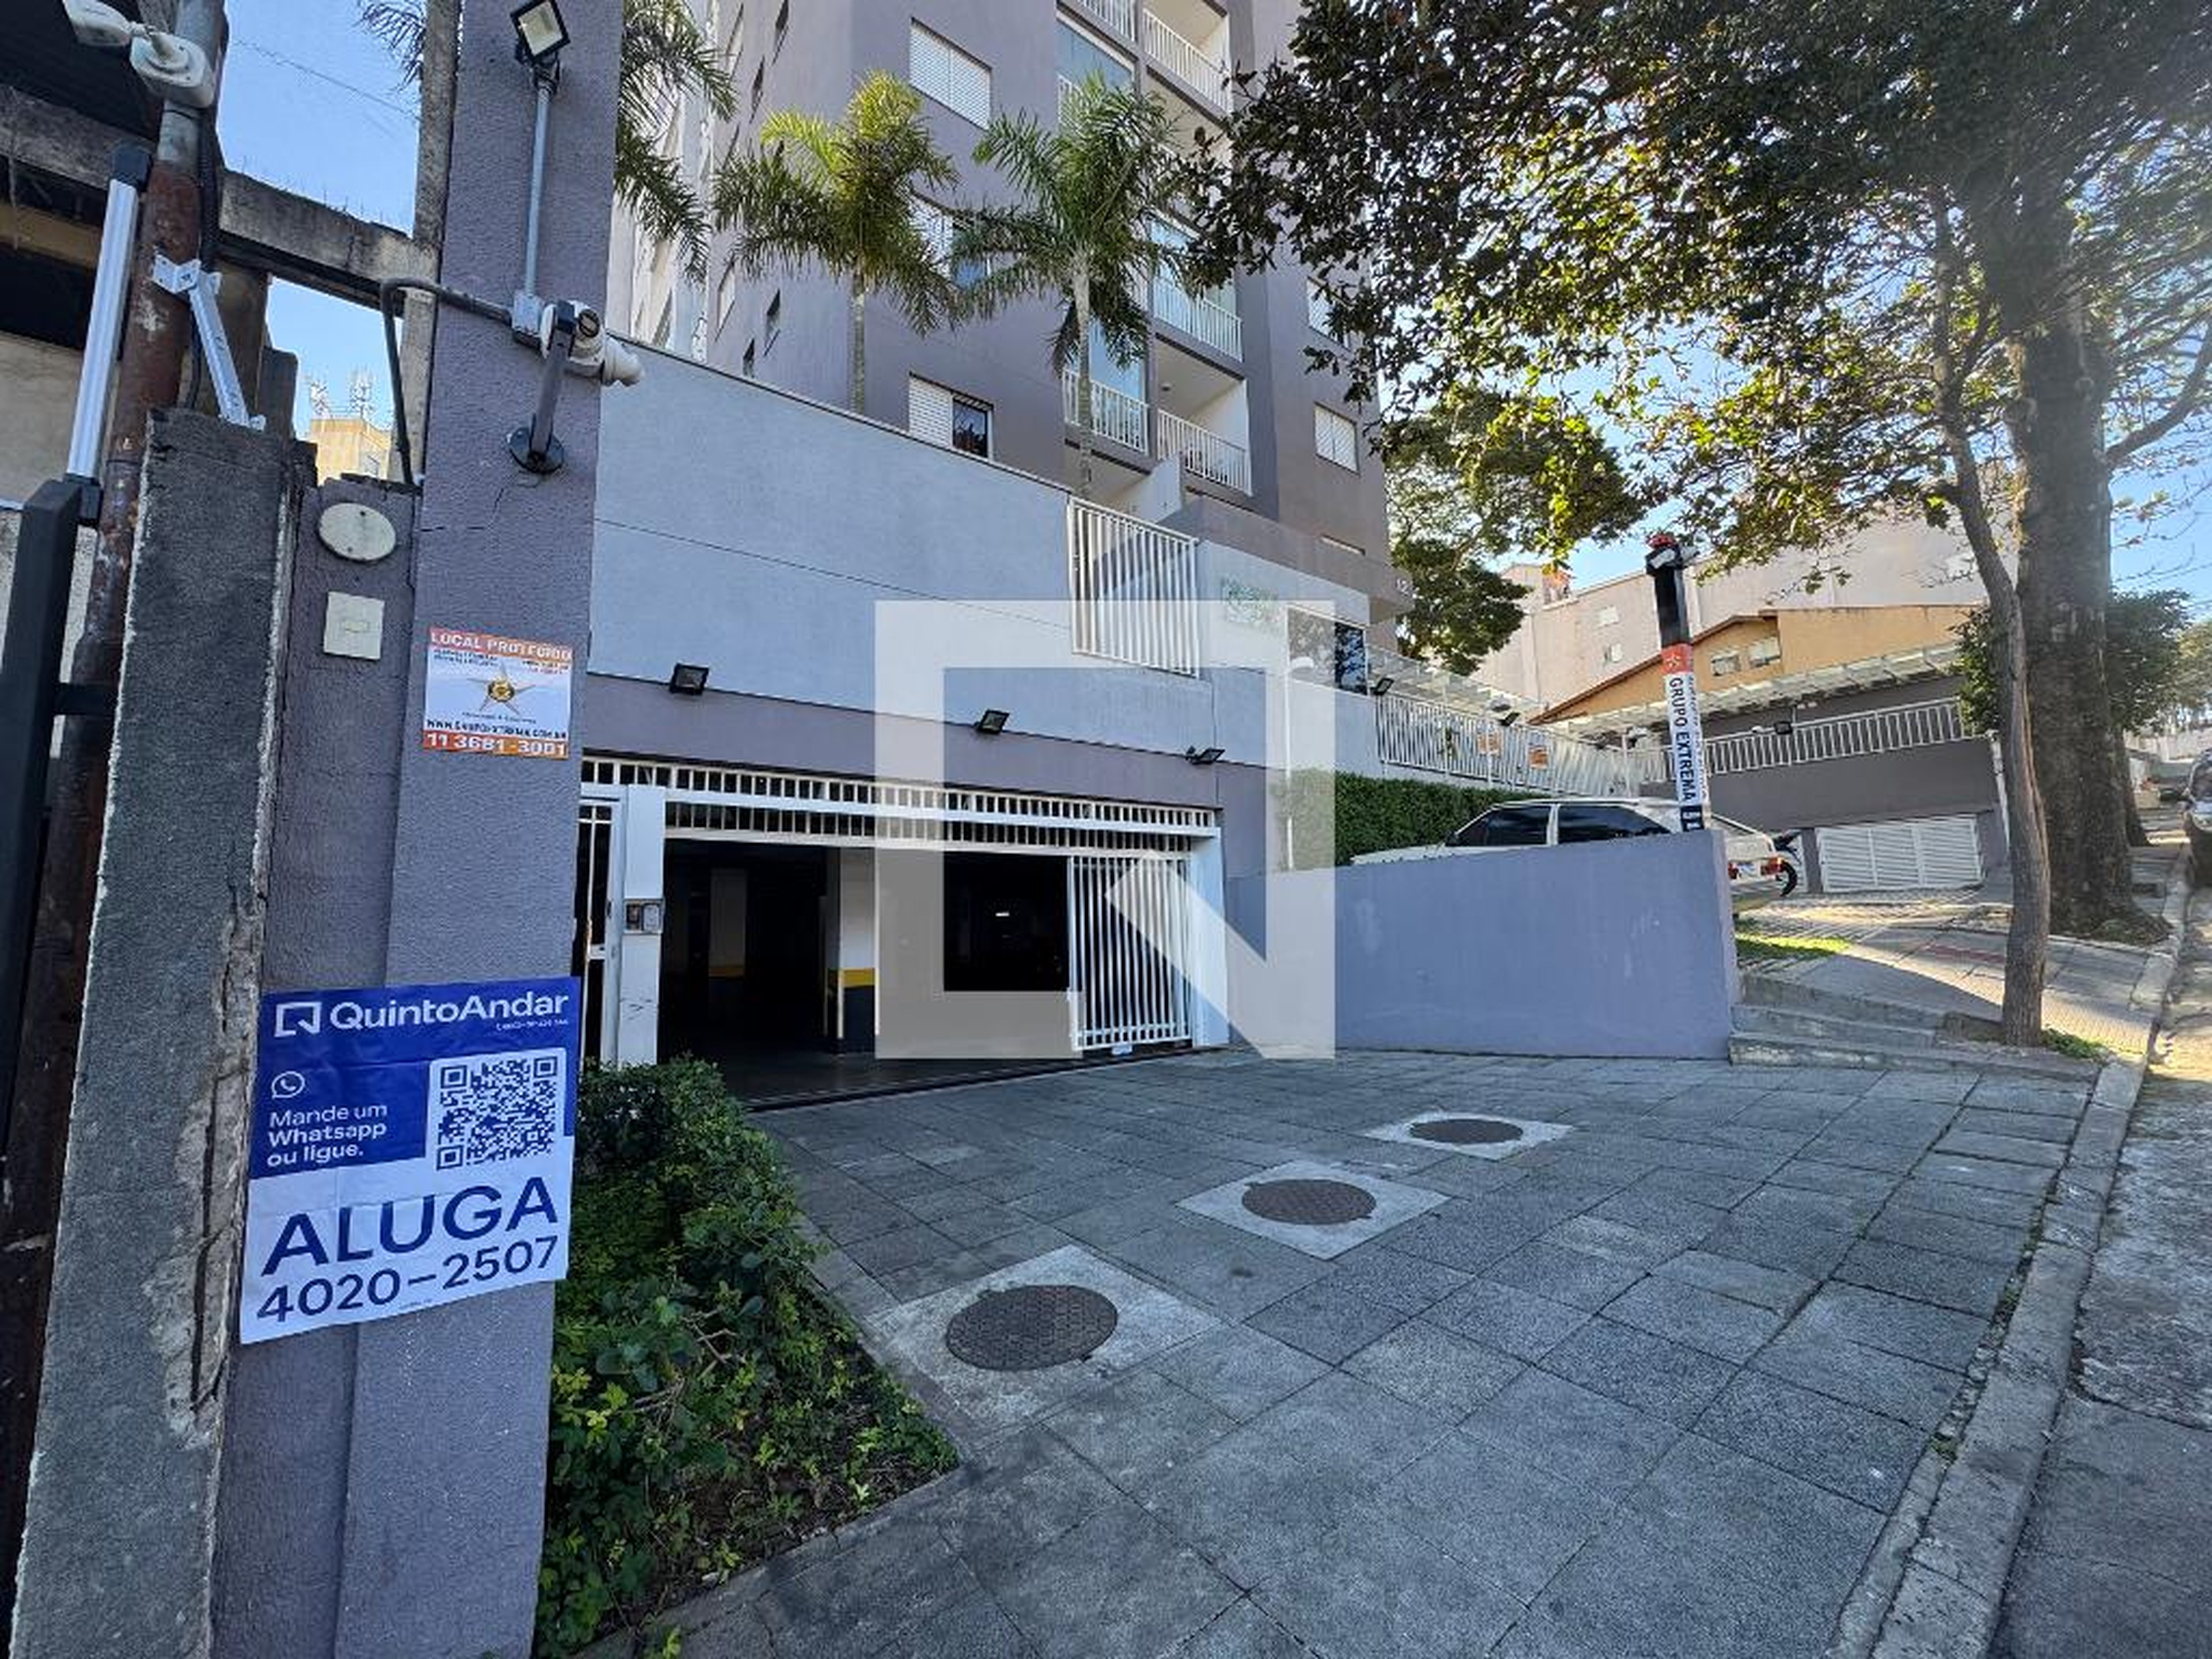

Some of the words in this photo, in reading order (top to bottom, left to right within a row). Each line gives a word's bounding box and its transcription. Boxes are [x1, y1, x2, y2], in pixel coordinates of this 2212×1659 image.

[431, 631, 482, 649] LOCAL
[1669, 677, 1688, 727] GRUPO
[427, 732, 448, 747] 11
[1676, 732, 1696, 801] EXTREMA
[330, 990, 569, 1031] QuintoAndar
[270, 1107, 349, 1127] Mande
[354, 1105, 388, 1120] um
[268, 1122, 387, 1148] Whatsapp
[267, 1151, 298, 1167] ou
[303, 1143, 364, 1165] ligue.
[260, 1176, 559, 1277] ALUGA
[256, 1235, 559, 1323] 4020-2507
